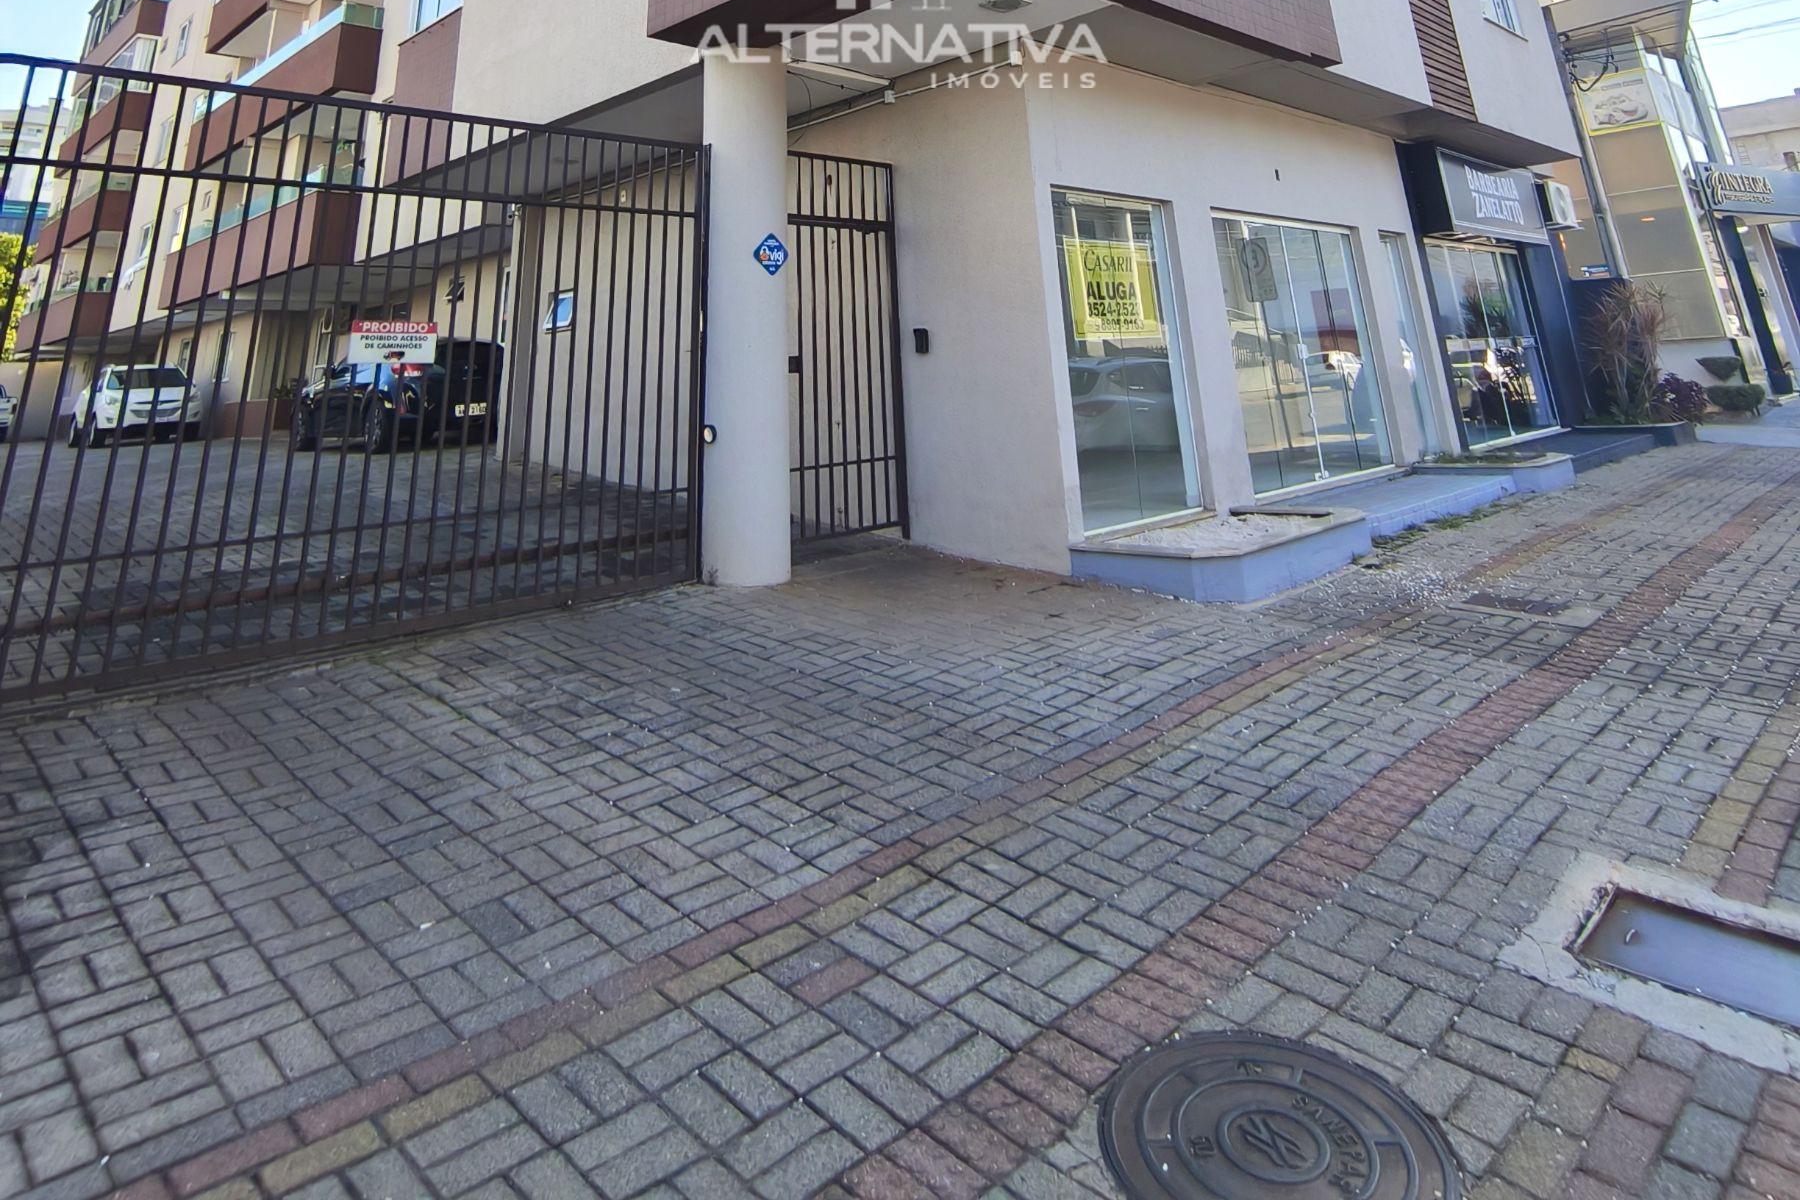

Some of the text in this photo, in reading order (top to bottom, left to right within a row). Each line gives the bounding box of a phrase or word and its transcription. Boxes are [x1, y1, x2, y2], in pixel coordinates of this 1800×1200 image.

[1464, 164, 1520, 200] BARBEARIA
[1720, 171, 1775, 195] INTEGRA
[1473, 191, 1525, 226] ZANELATTO
[1087, 281, 1136, 300] ALUGA
[362, 321, 429, 333] PROIBIDO
[360, 334, 429, 342] PROIBIDO ACESSO
